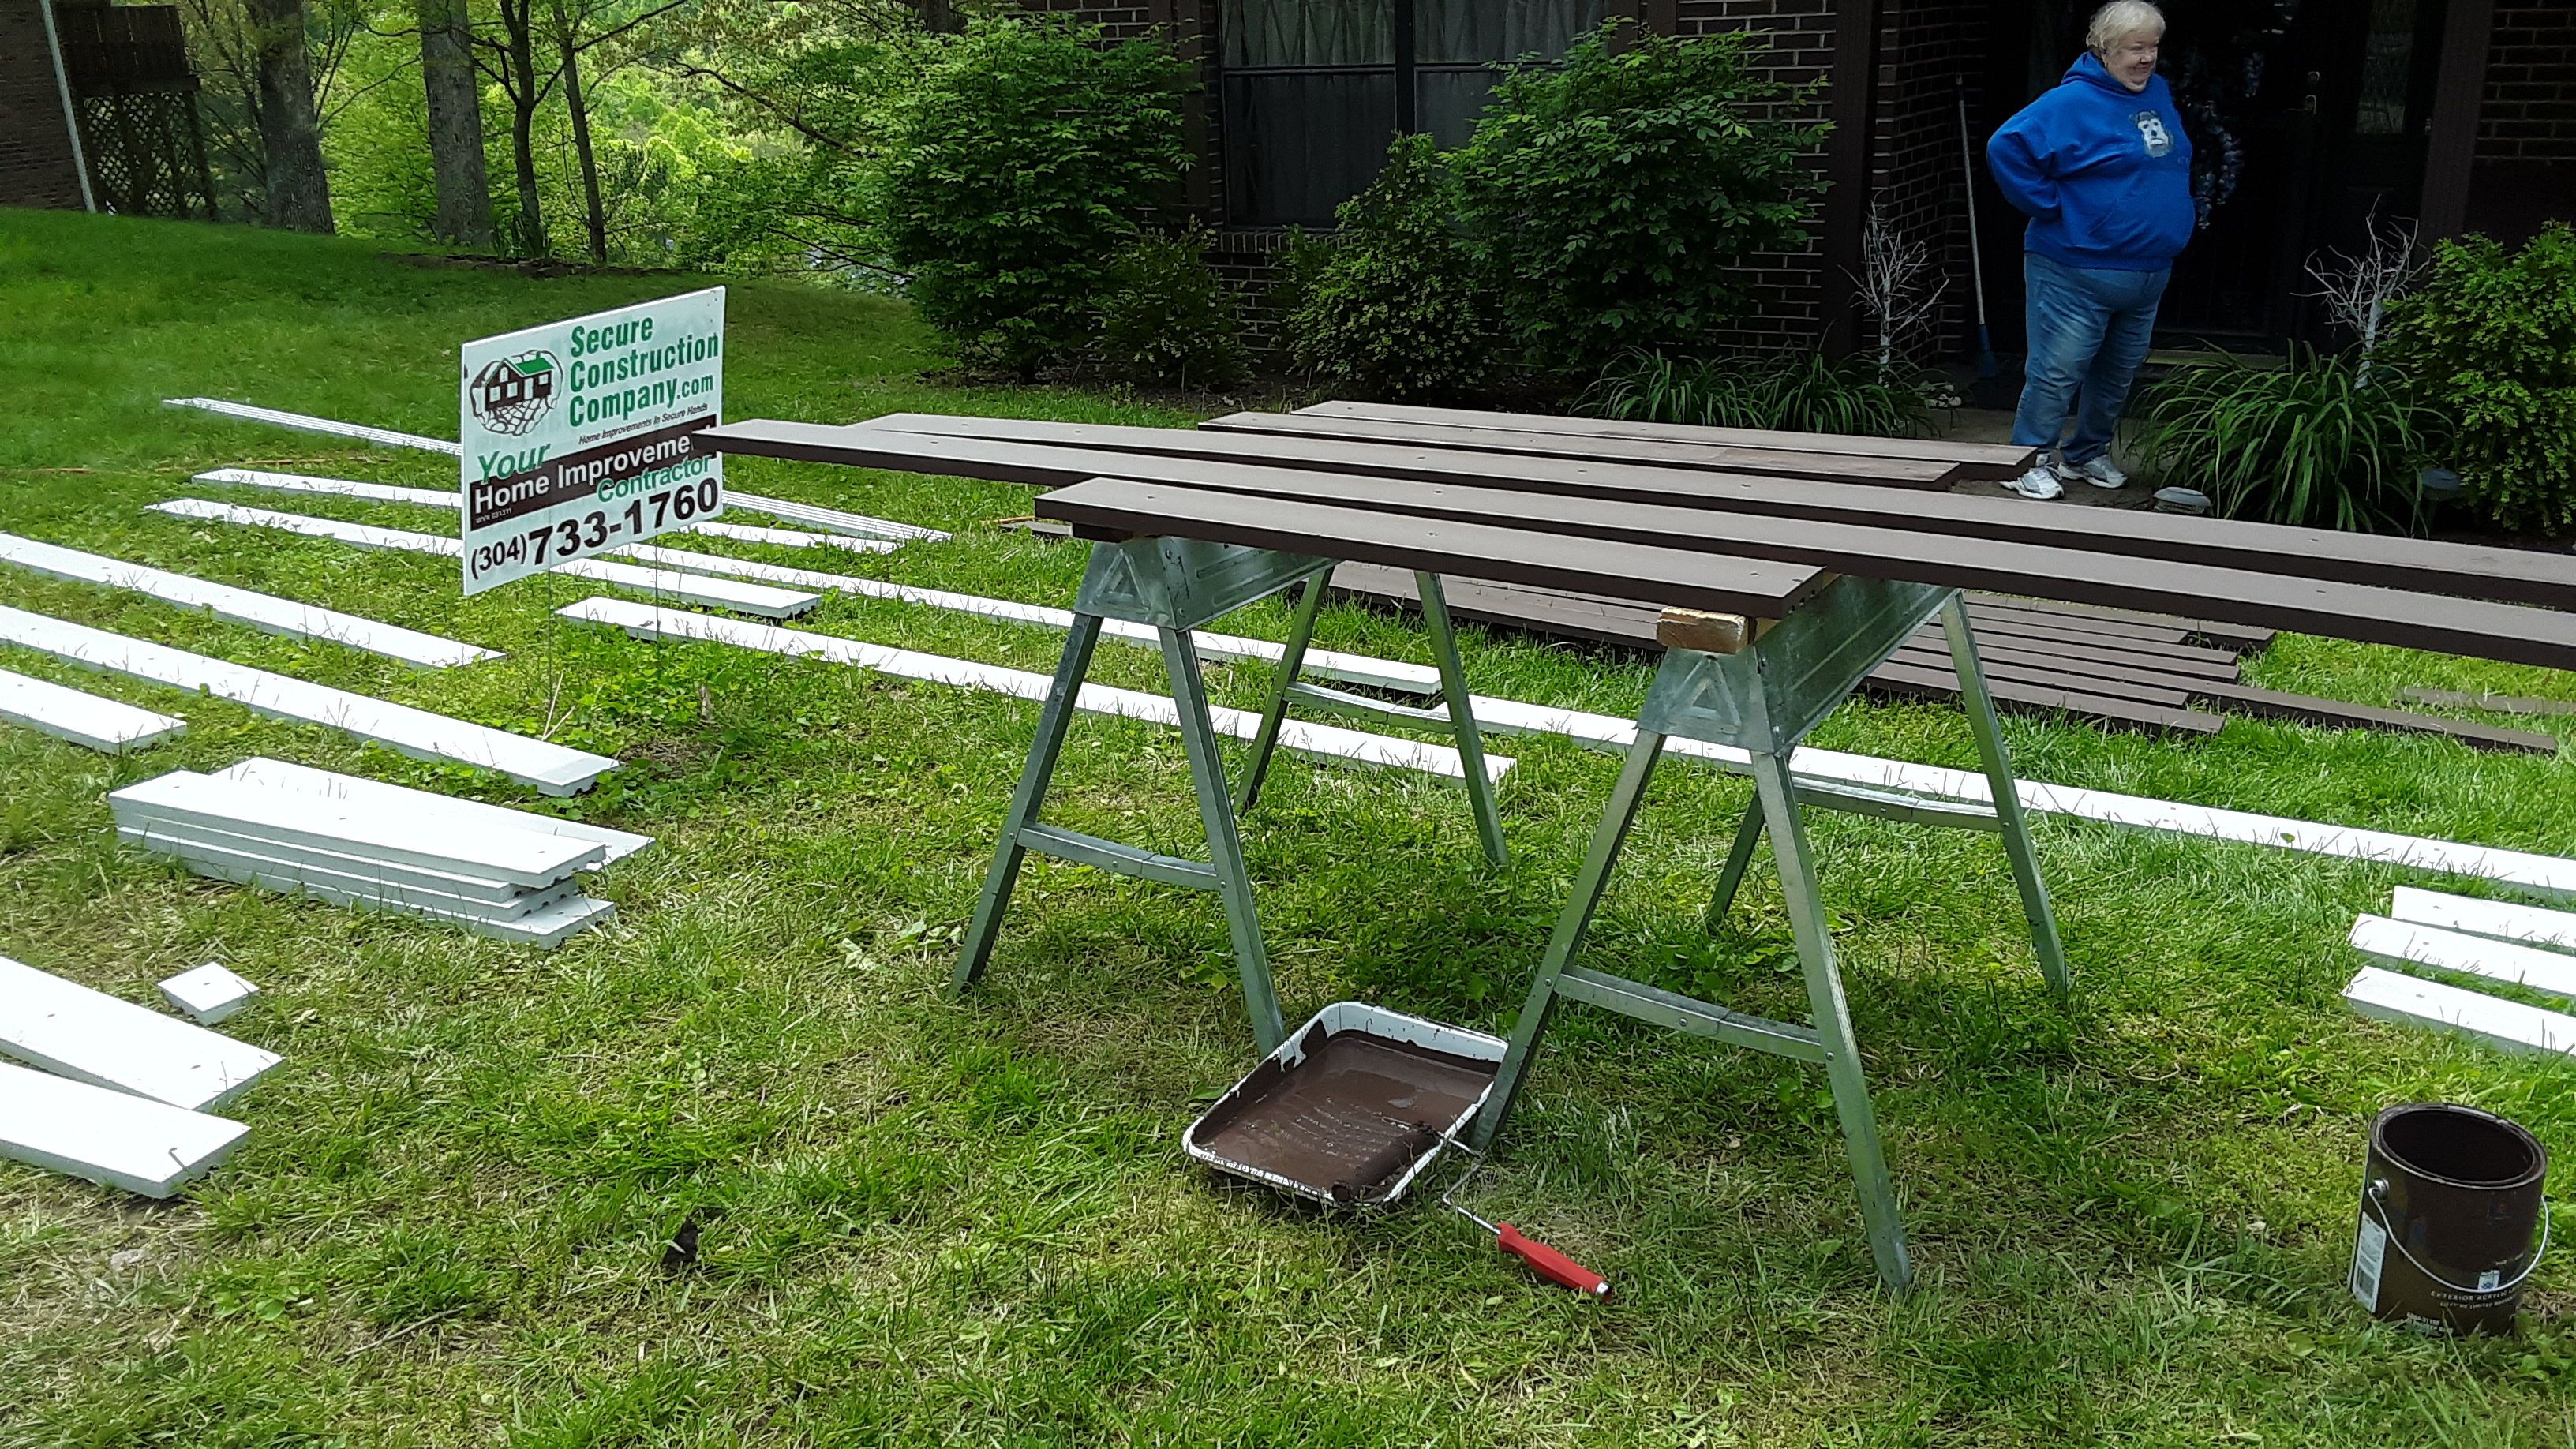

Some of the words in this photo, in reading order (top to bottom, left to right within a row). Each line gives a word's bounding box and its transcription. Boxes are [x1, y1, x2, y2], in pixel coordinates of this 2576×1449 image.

[571, 316, 653, 358] Secure
[569, 332, 719, 393] Construction
[569, 373, 714, 427] Company.com
[578, 433, 600, 445] Home
[602, 419, 652, 439] Improvements
[653, 415, 661, 425] In
[661, 410, 686, 423] Secure
[687, 402, 708, 416] Hands
[475, 474, 549, 514] Home
[558, 435, 695, 489] Improveme
[477, 443, 551, 485] Your
[597, 455, 712, 503] Contractor
